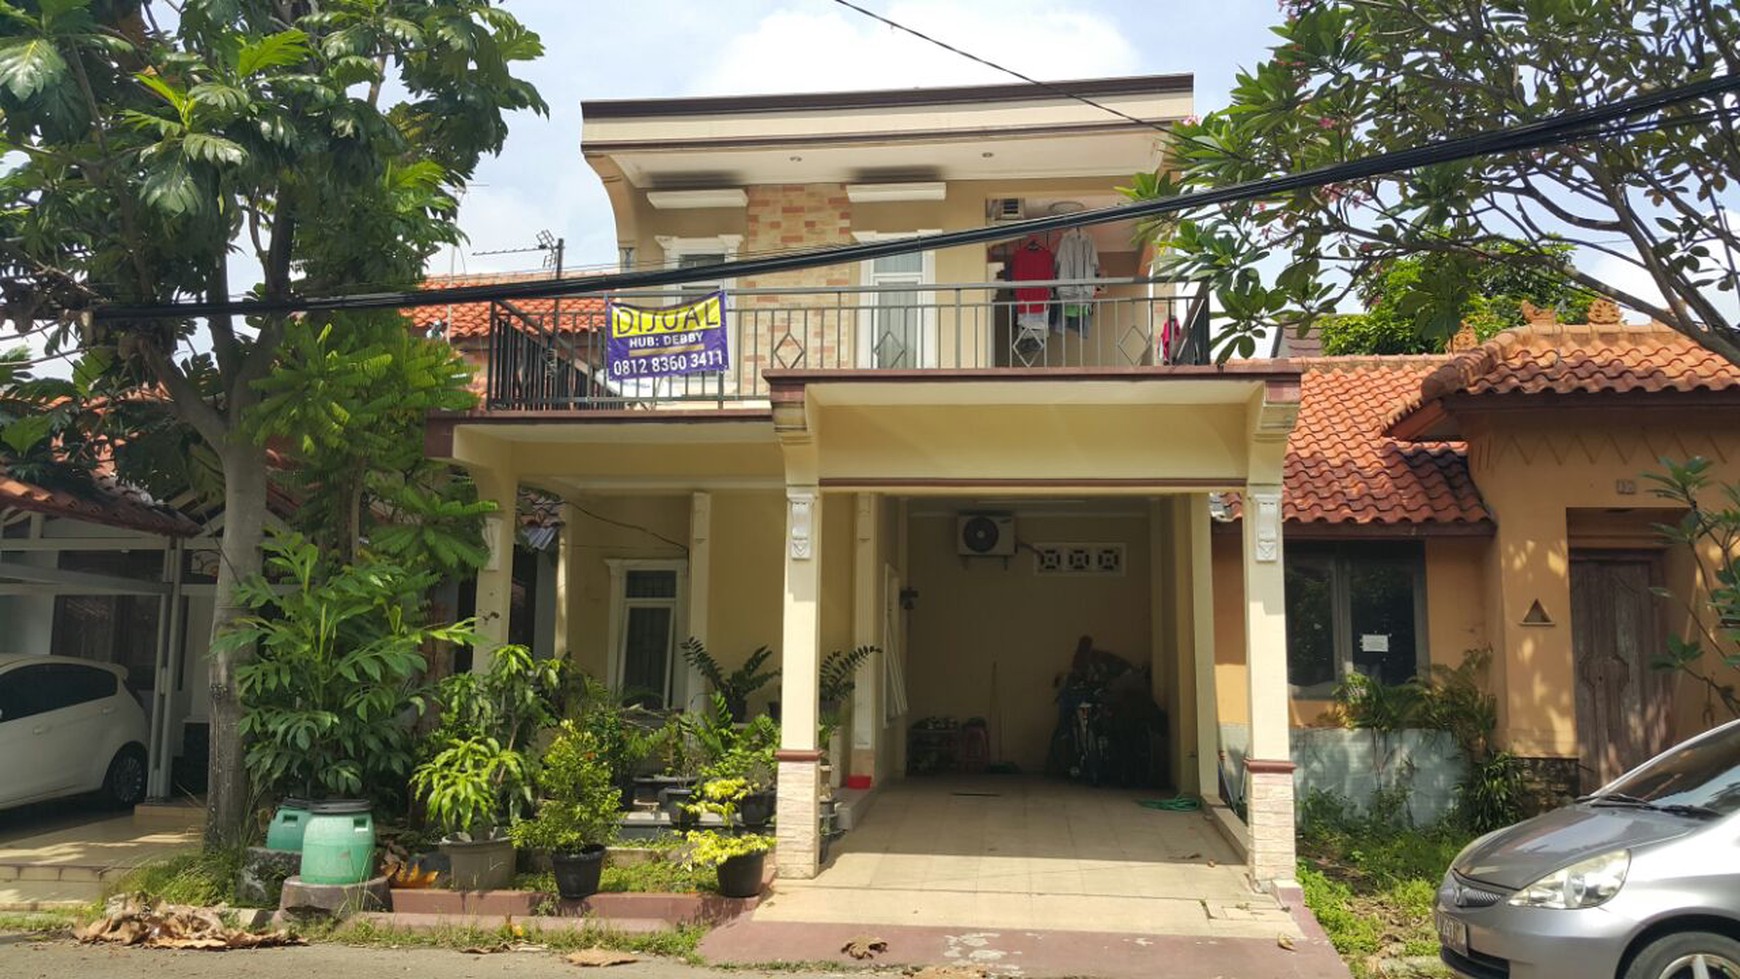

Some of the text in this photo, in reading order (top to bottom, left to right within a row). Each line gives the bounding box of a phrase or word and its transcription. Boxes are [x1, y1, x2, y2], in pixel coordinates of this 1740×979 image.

[617, 302, 719, 335] DIJUAL
[629, 332, 704, 348] HUB: DEBBY
[613, 349, 723, 376] 0812 8360 3411
